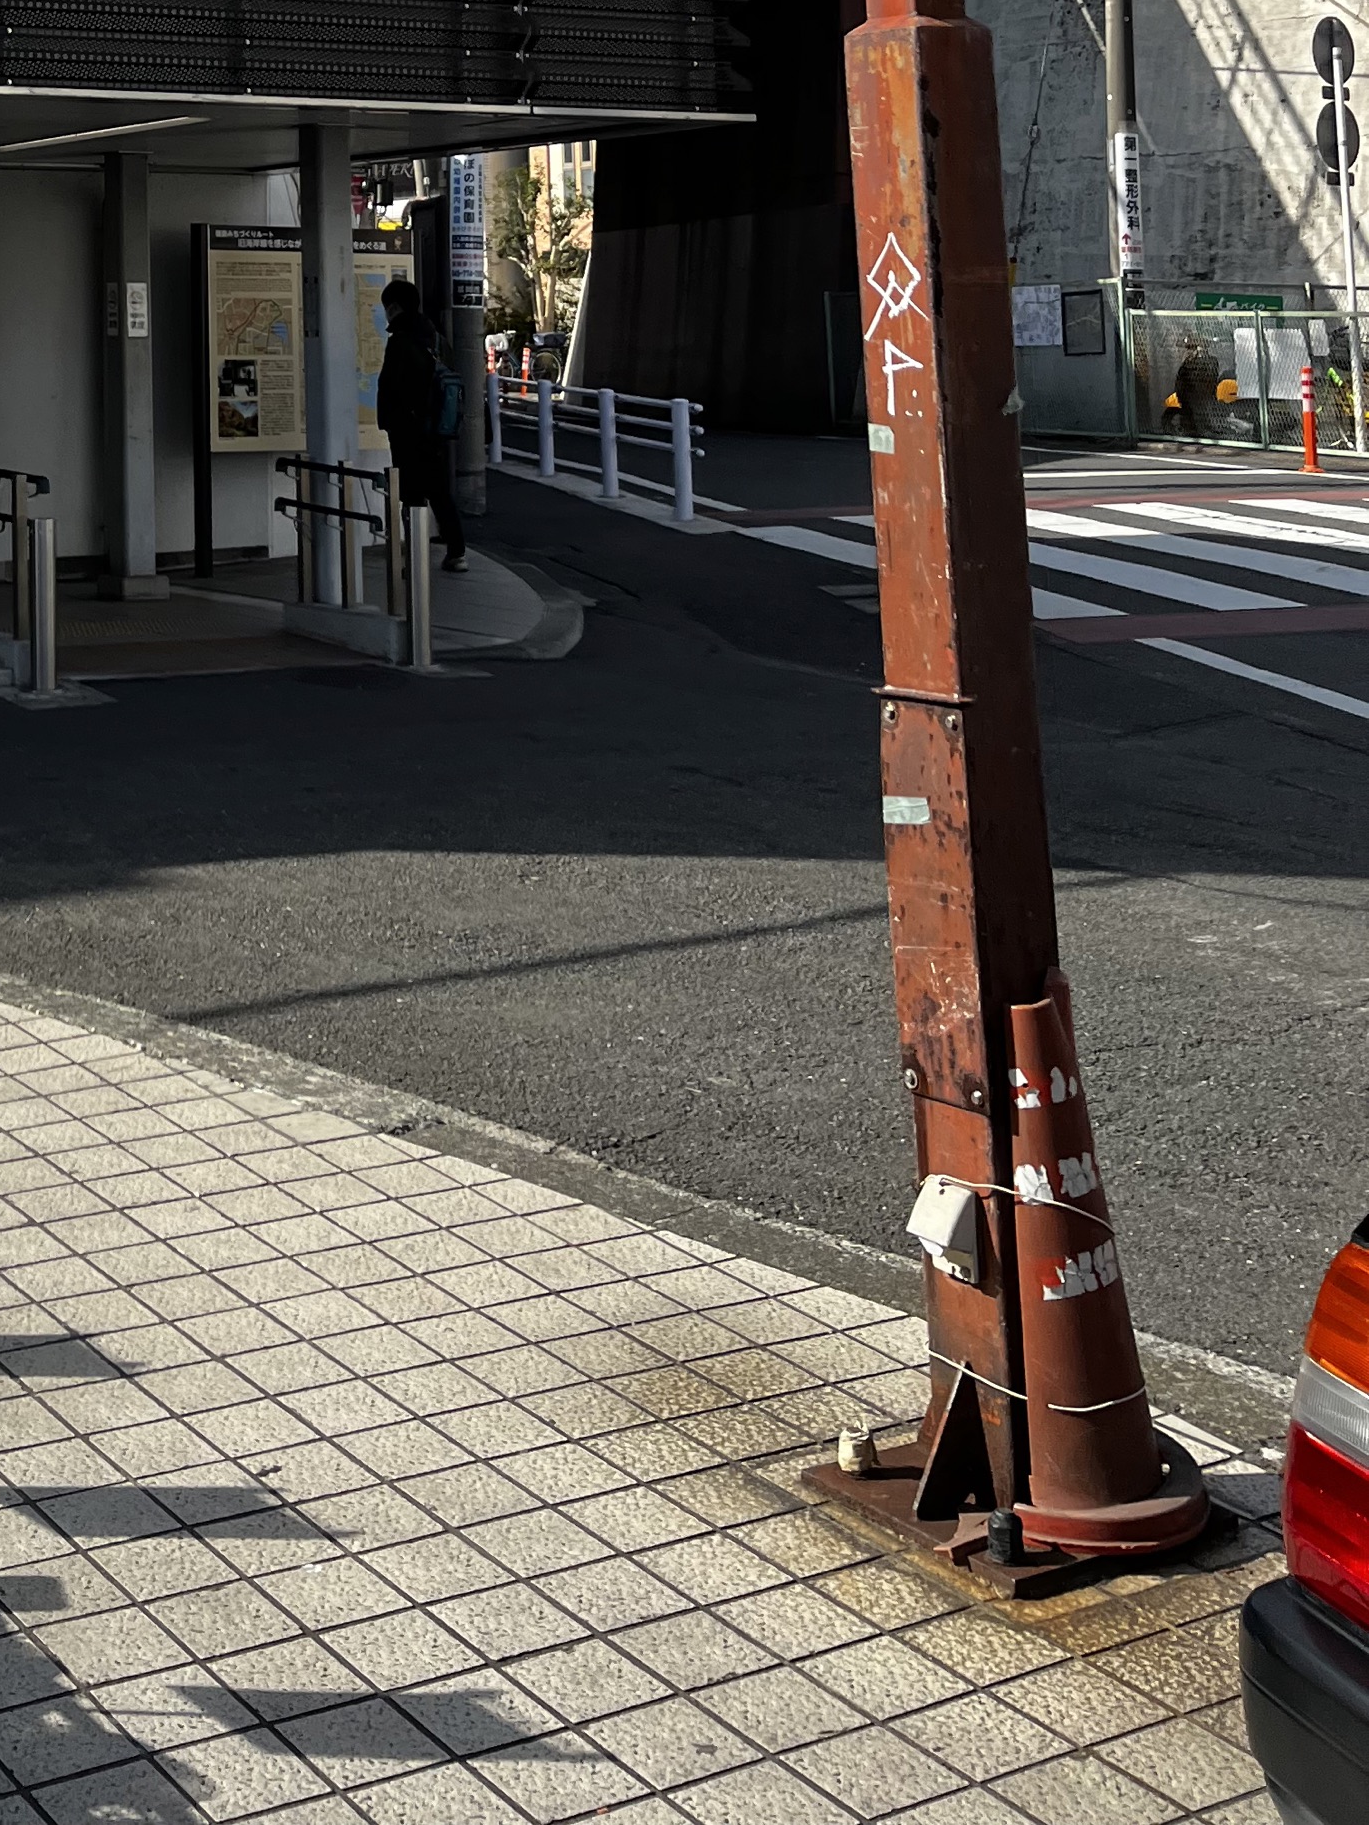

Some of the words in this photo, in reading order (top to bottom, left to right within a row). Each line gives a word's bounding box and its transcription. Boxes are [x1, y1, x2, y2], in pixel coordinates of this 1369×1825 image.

[1124, 136, 1141, 232] 第一整形外科
